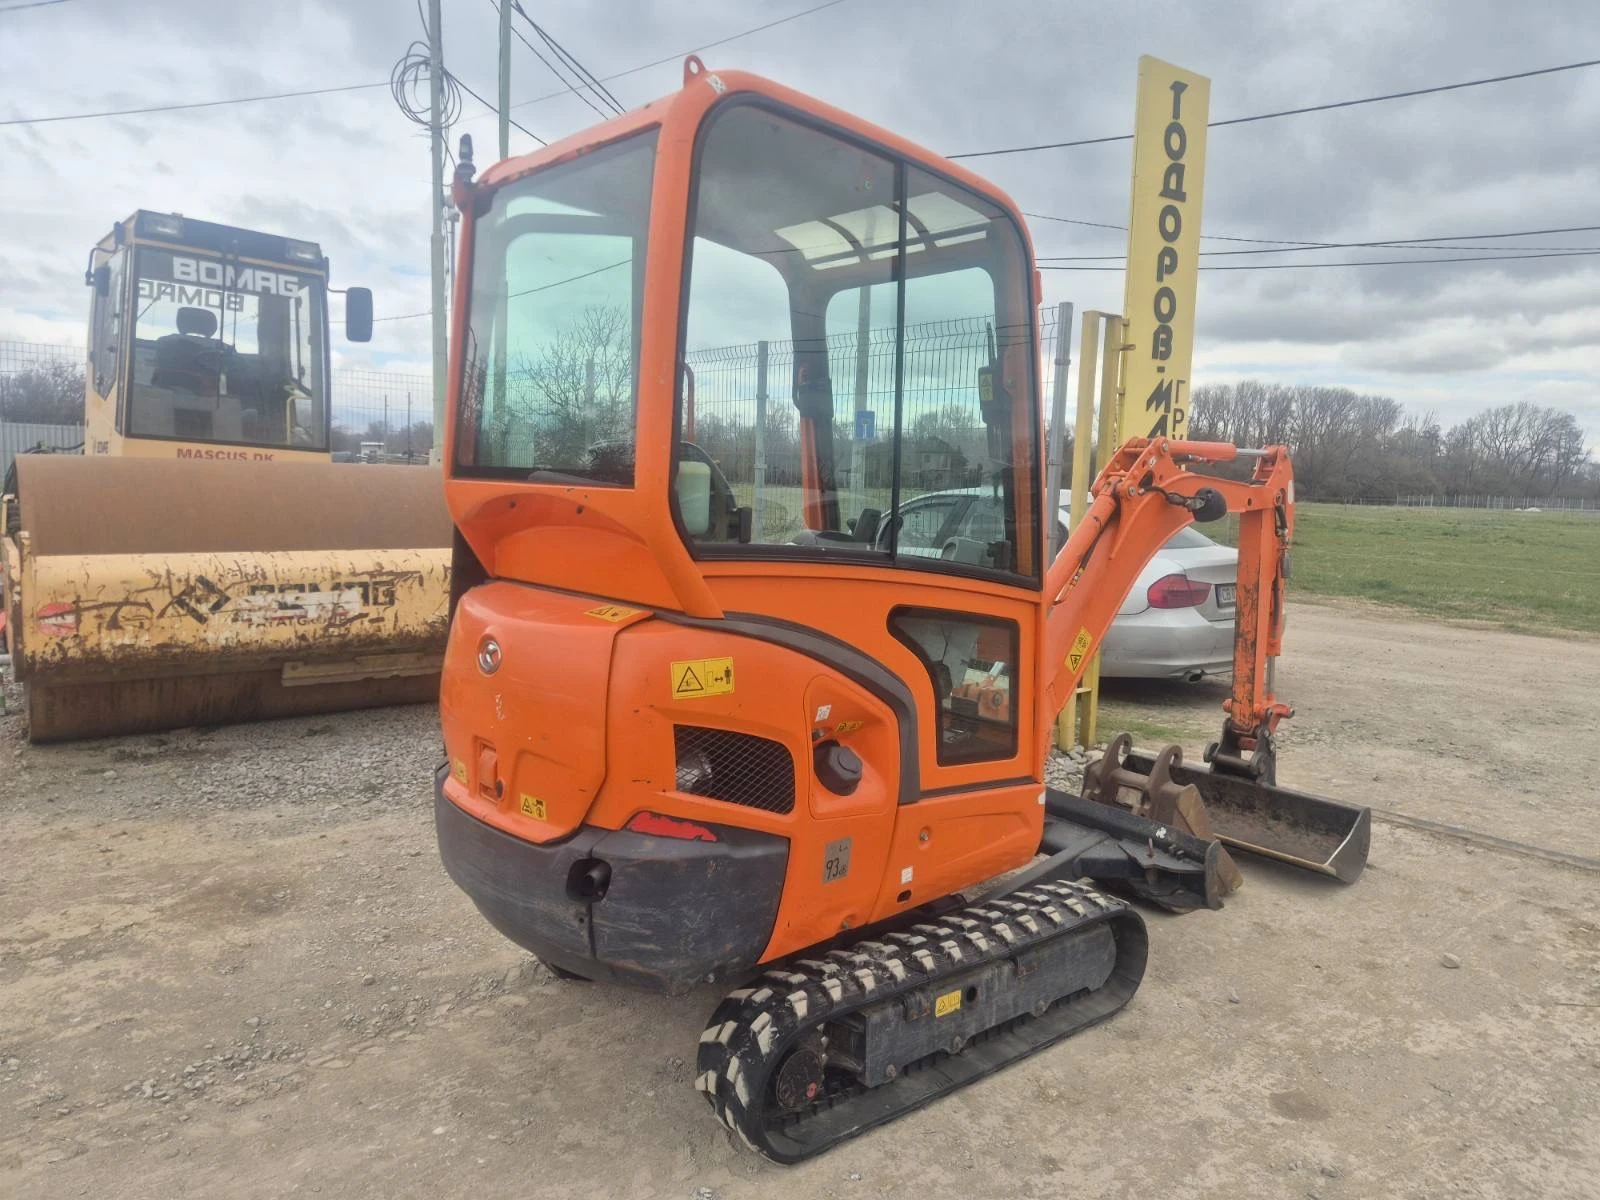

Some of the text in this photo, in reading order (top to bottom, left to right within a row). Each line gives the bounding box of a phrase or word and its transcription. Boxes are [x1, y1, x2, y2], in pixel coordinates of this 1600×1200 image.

[173, 256, 299, 298] BOMAG
[1171, 379, 1186, 441] ГР
[176, 448, 248, 461] MASCUS
